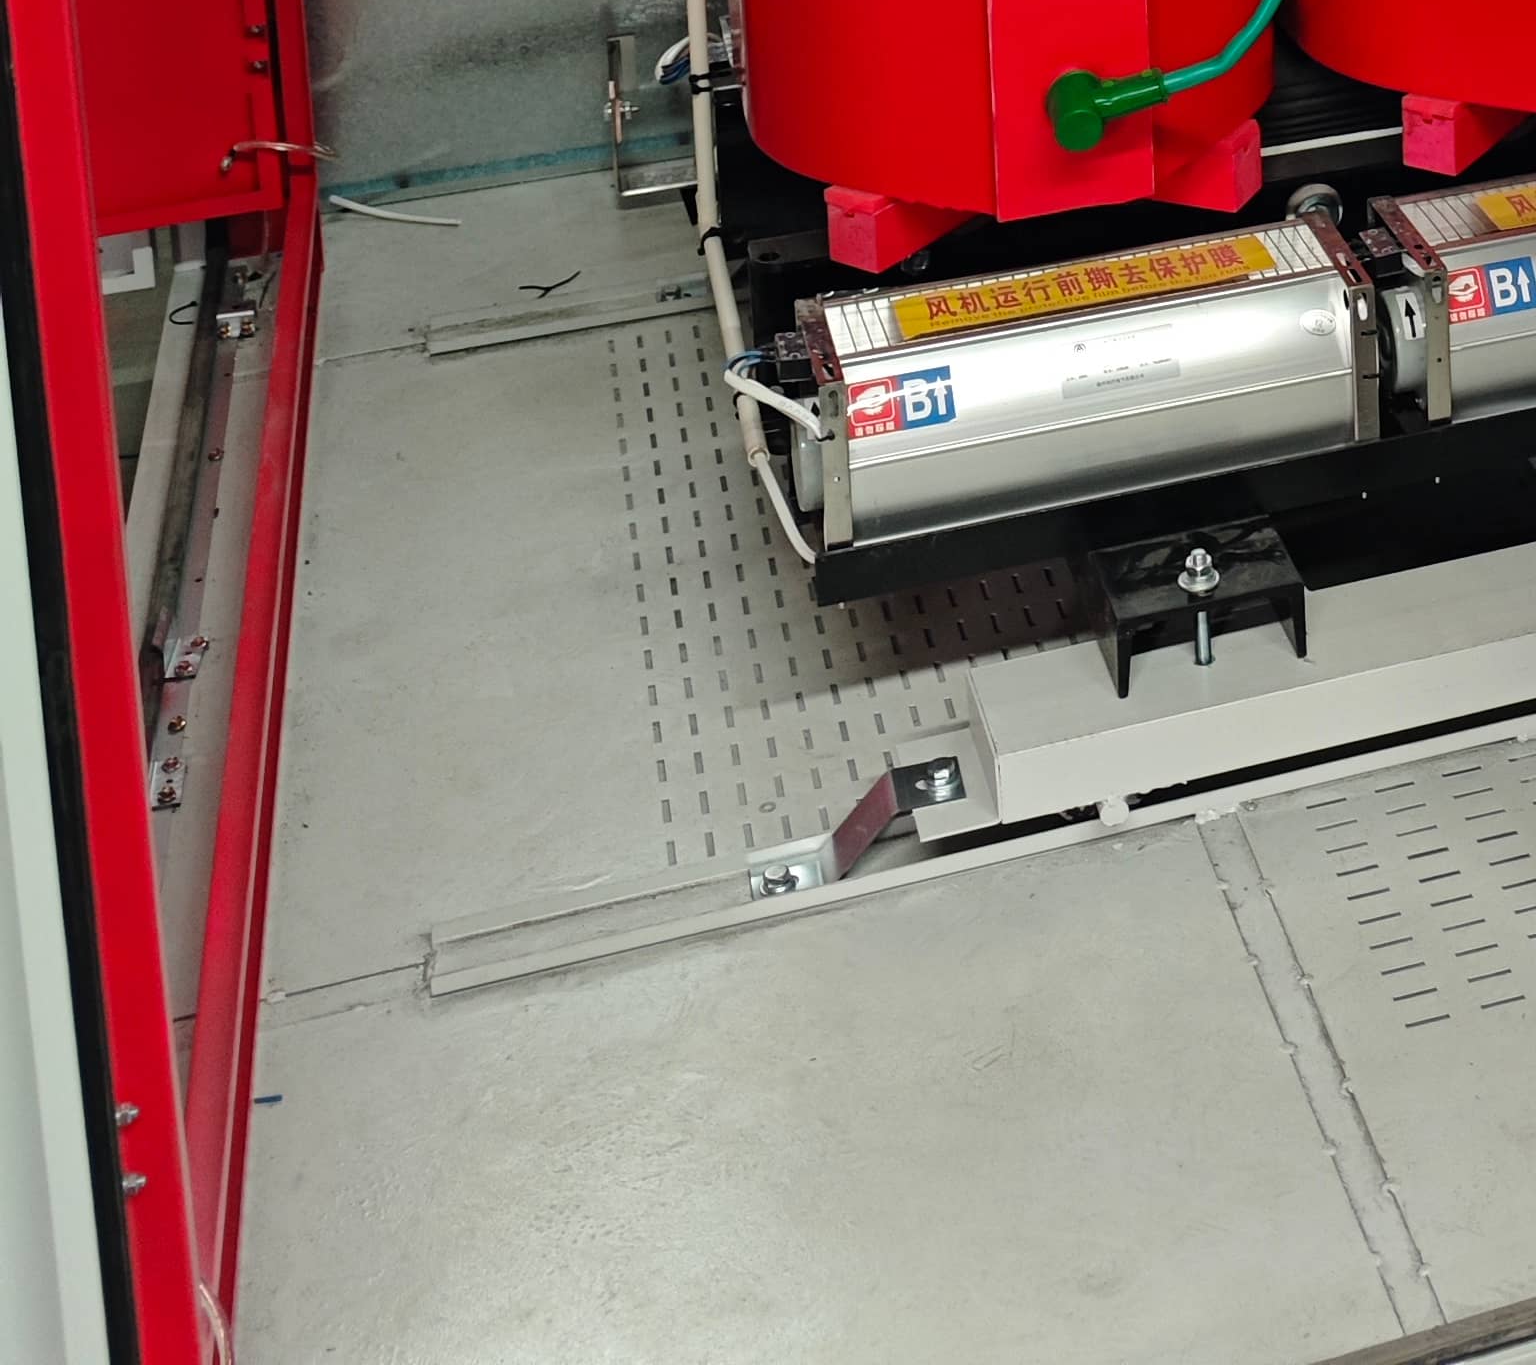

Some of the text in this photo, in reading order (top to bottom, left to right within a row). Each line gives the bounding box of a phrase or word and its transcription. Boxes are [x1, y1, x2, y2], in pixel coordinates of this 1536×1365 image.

[925, 244, 1244, 320] 风机运行前撕去保护膜
